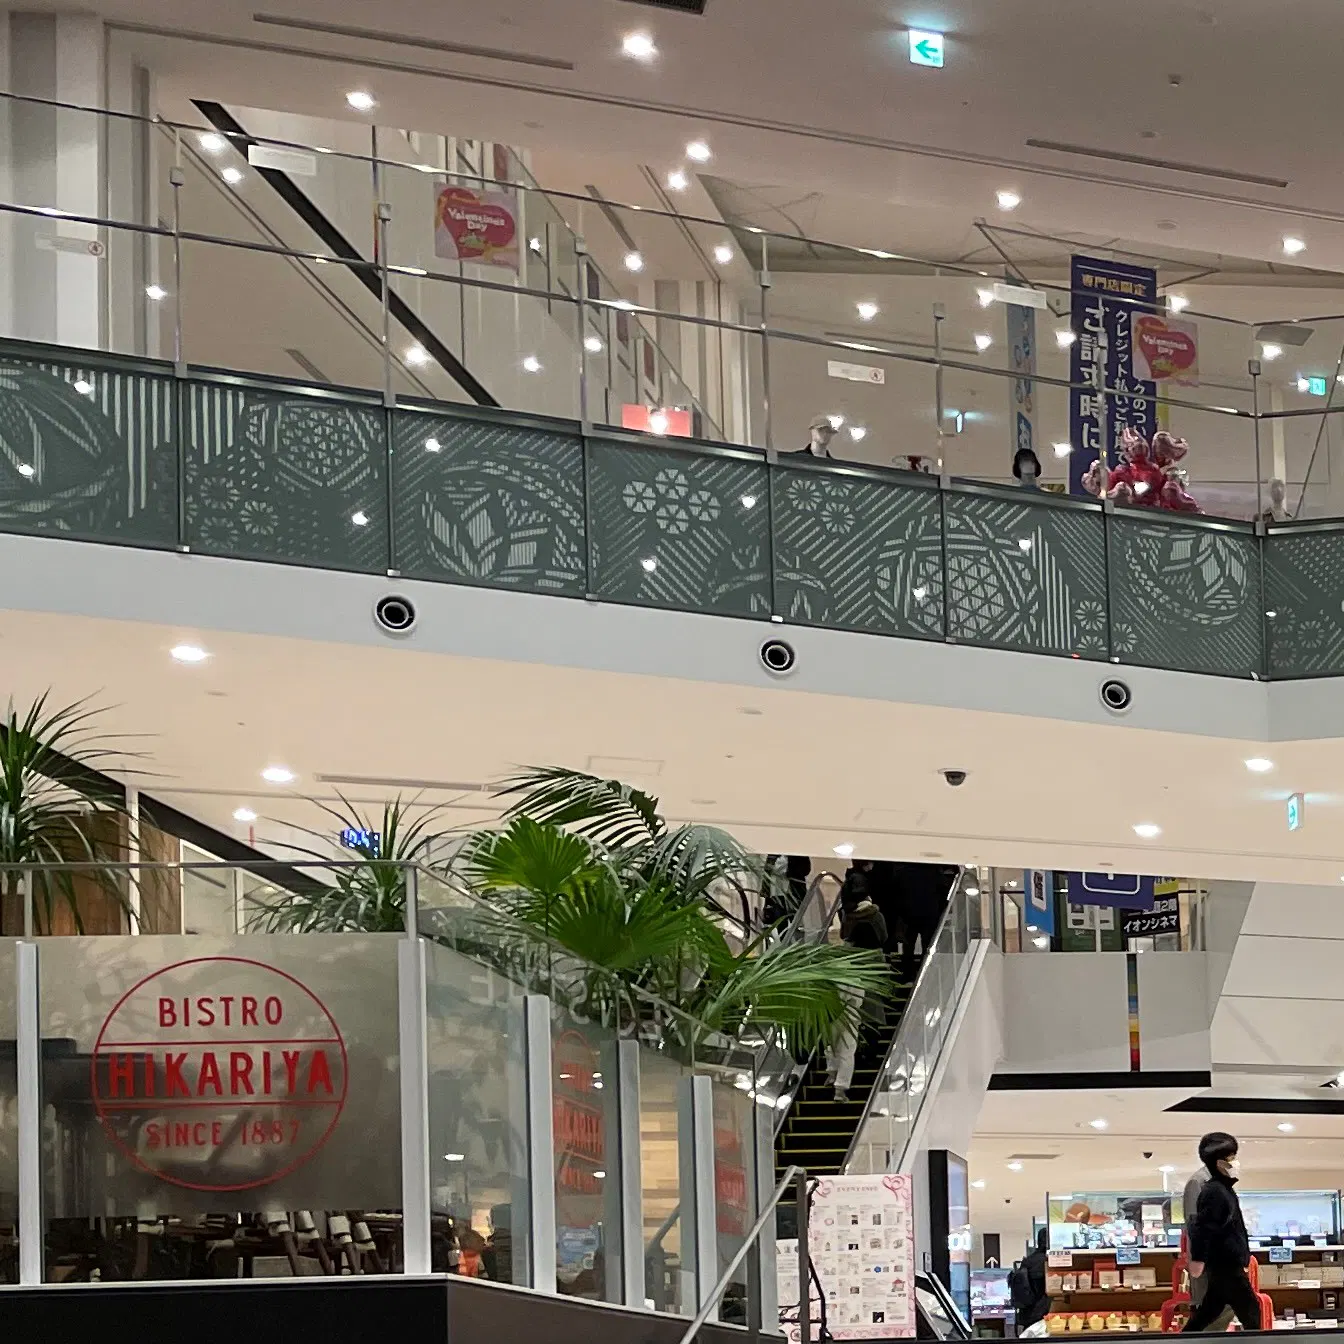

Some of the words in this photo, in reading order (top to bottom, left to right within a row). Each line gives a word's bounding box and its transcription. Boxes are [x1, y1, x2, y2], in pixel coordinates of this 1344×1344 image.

[1123, 914, 1179, 934] イオンシネマ
[158, 995, 283, 1028] BISTRO
[108, 1049, 334, 1098] HIKARIYA
[145, 1121, 223, 1148] SINCE
[241, 1119, 302, 1146] 1887
